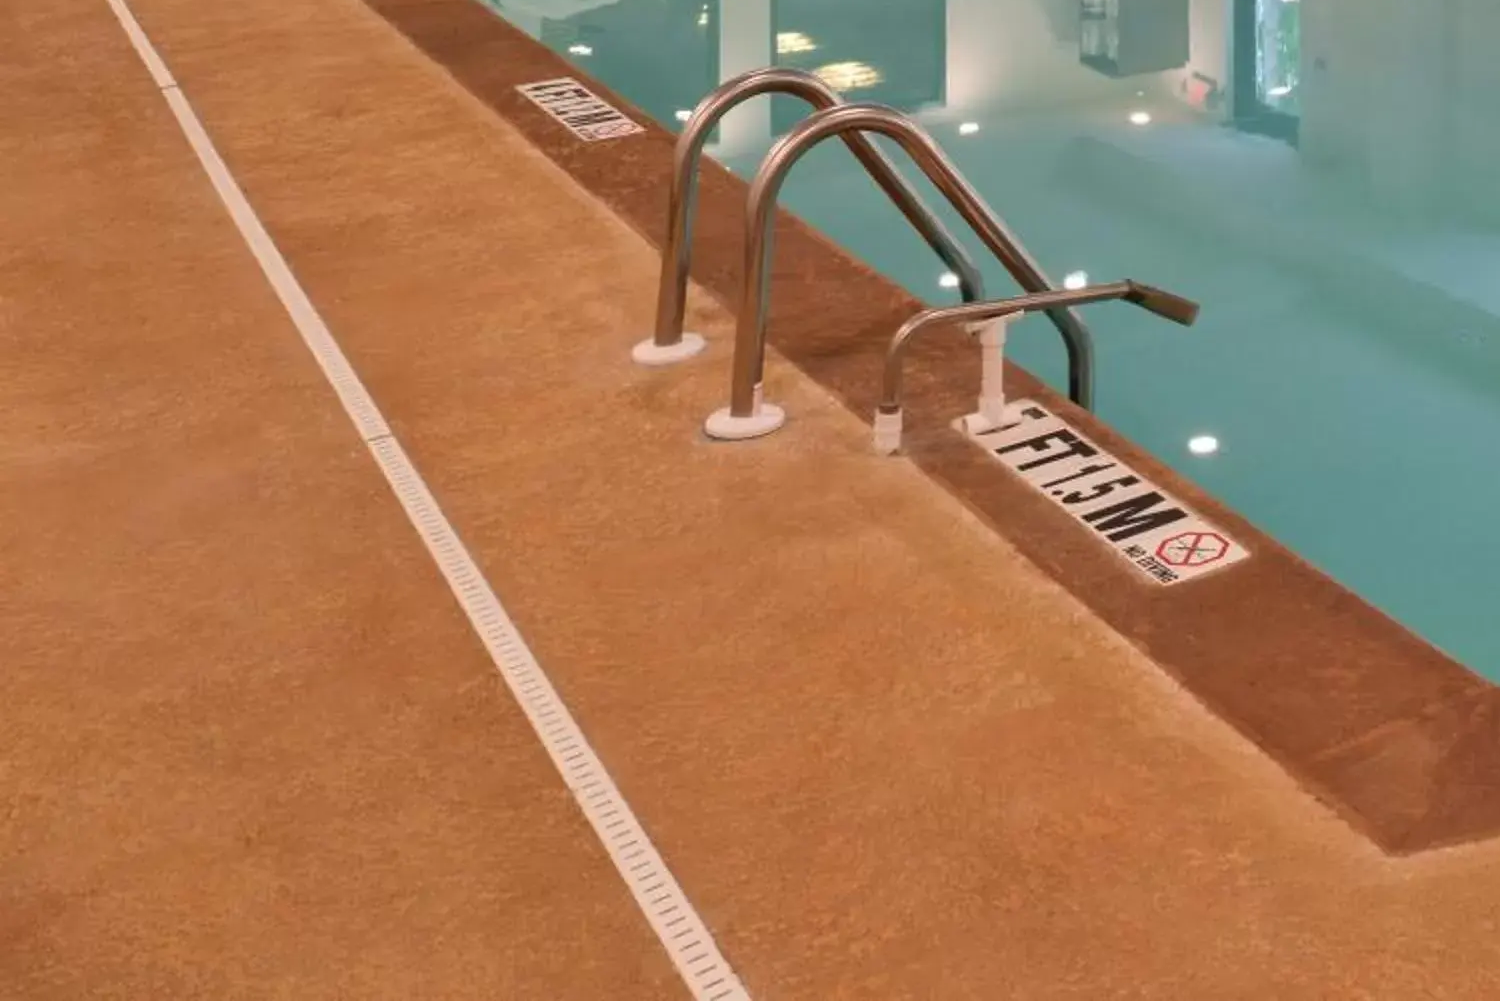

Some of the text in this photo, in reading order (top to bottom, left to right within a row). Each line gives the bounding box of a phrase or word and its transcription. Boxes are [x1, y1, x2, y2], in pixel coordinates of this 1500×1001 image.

[995, 428, 1099, 472] FT
[1041, 462, 1141, 505] 1.5
[1081, 490, 1189, 543] M
[1122, 544, 1147, 559] NO
